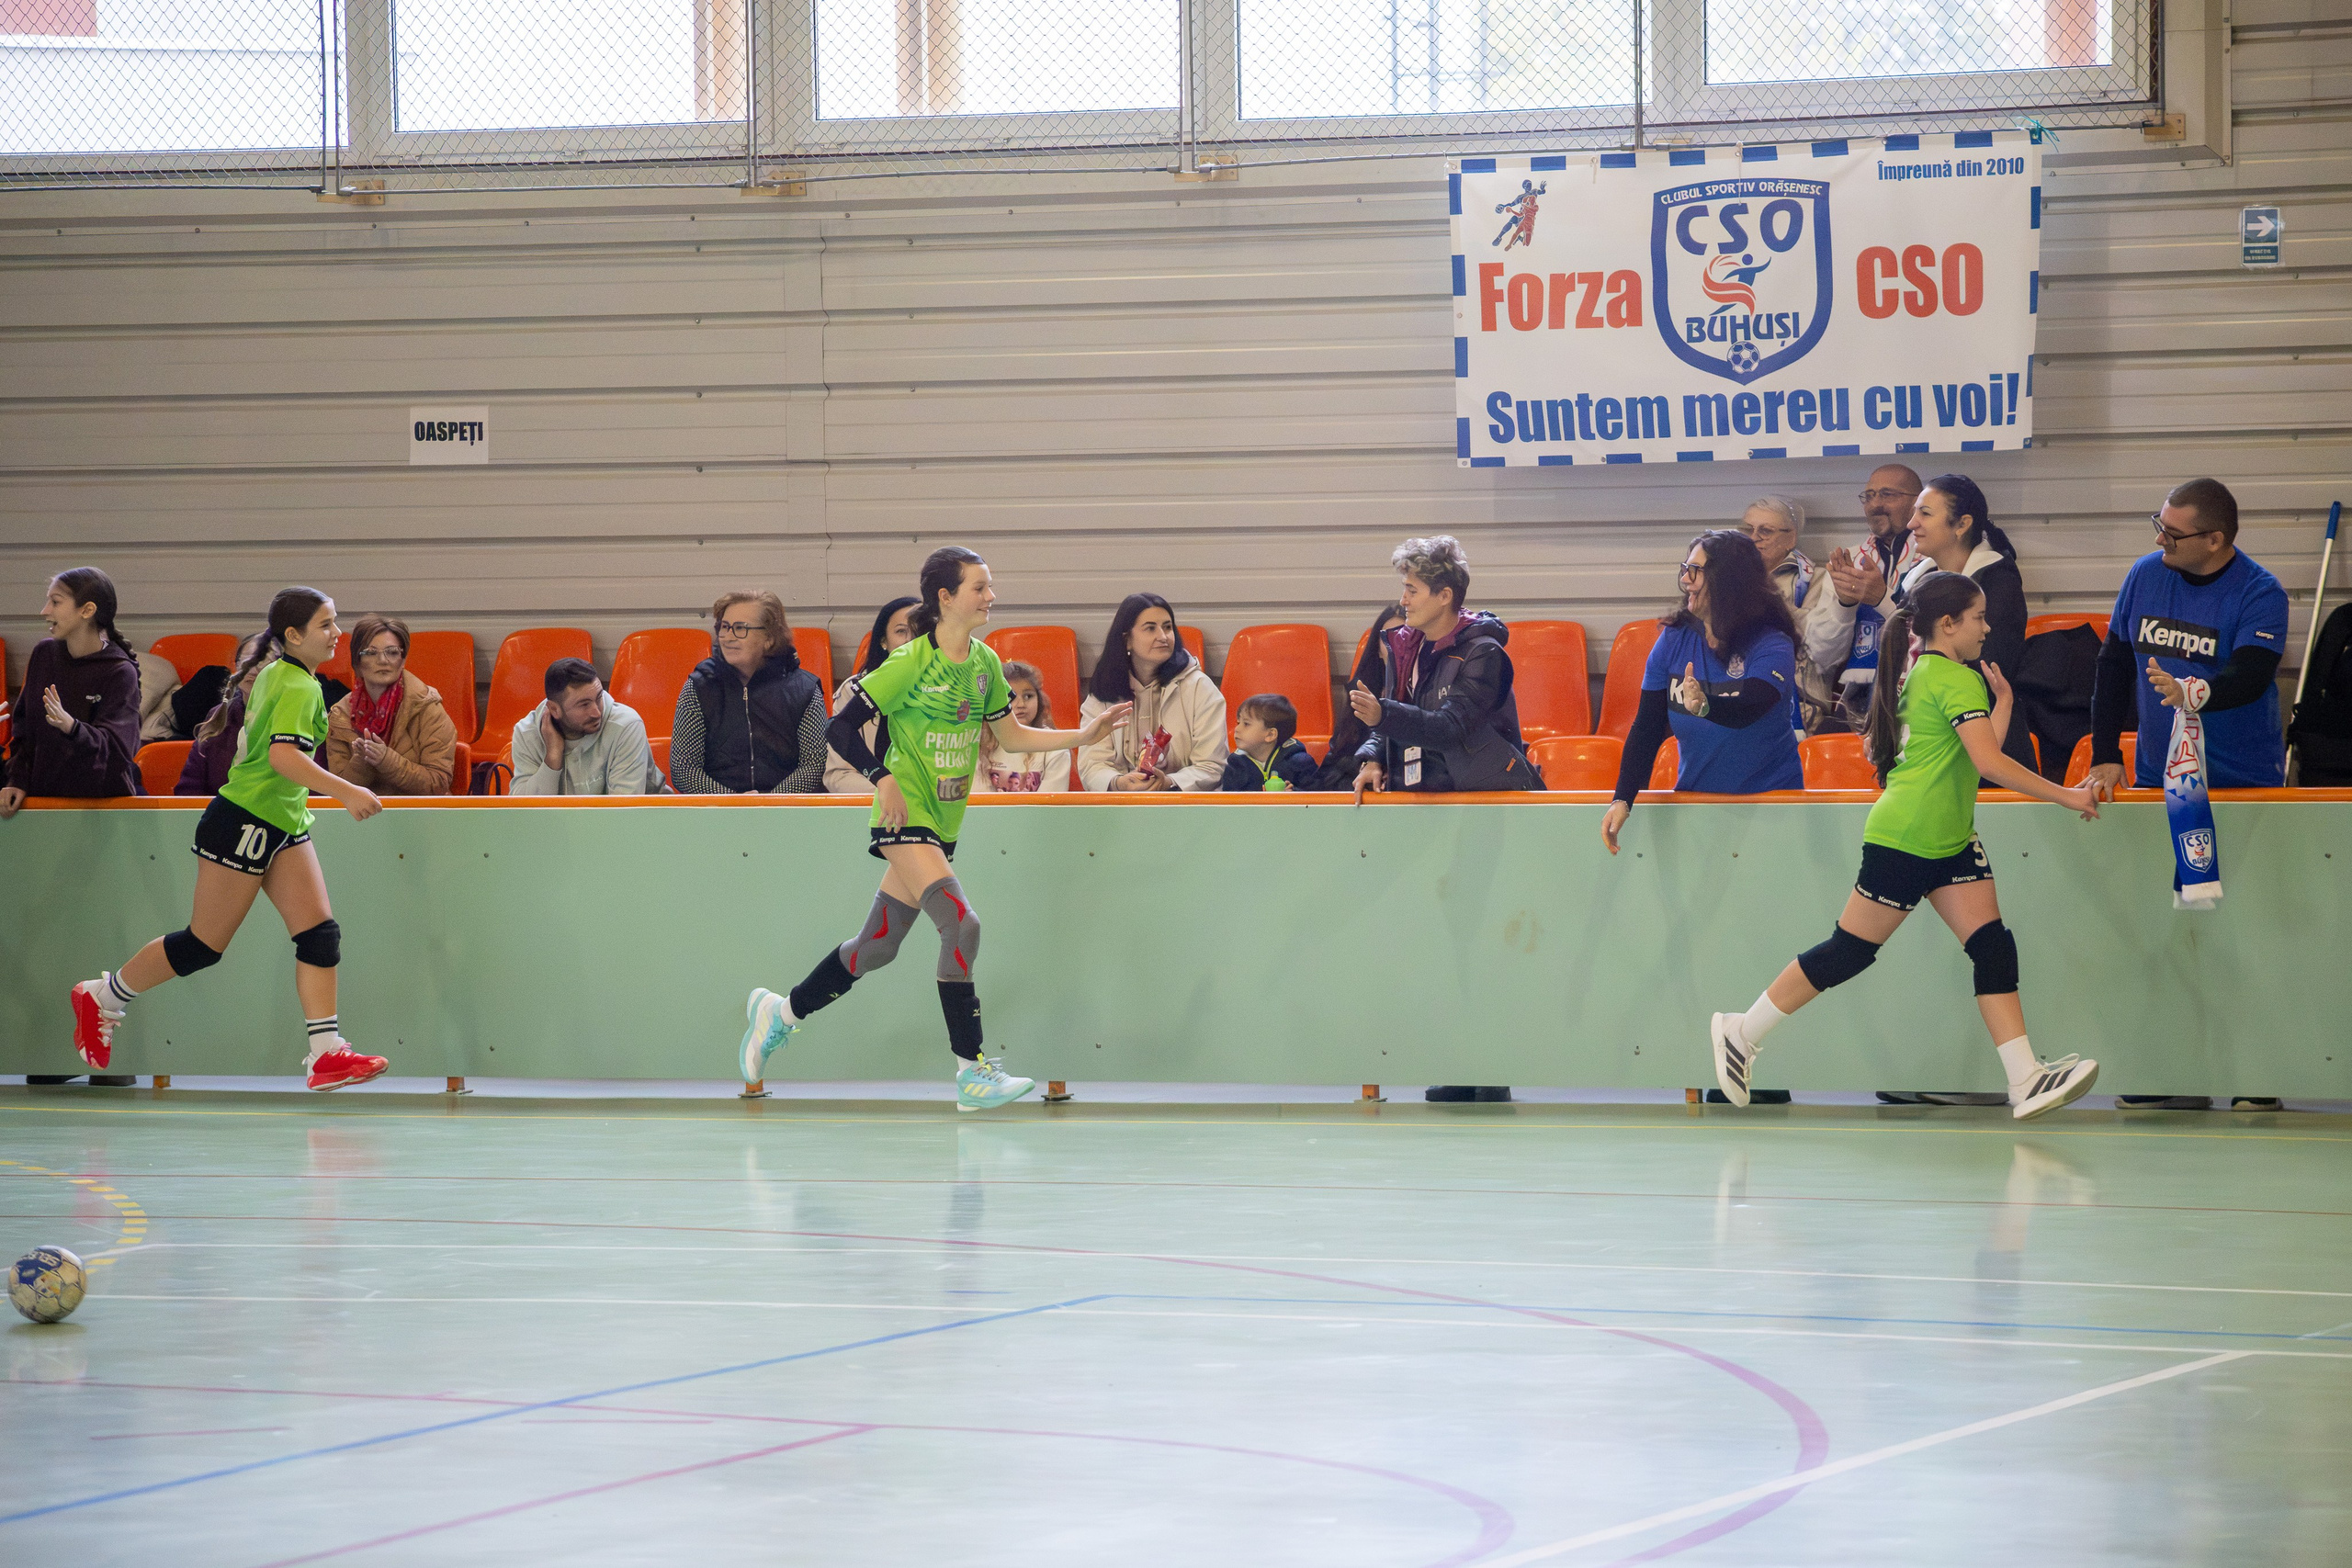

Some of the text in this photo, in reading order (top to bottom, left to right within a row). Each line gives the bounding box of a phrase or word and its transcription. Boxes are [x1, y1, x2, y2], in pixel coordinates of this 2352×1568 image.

[1877, 157, 2025, 181] Împreună din 2010
[1660, 187, 1703, 205] CLUBUL
[1705, 182, 1756, 197] SPORTIV
[1676, 198, 1804, 255] CSO
[1856, 243, 1984, 319] CSO
[1478, 262, 1644, 332] Forza
[1486, 372, 2019, 444] Suntem mereu cu voi!
[414, 421, 483, 446] OASPEȚI
[2138, 618, 2216, 658] Kempa
[1962, 711, 1985, 719] Kempa
[234, 823, 268, 861] 10
[900, 835, 922, 843] Kempa
[2186, 833, 2210, 847] CSO
[199, 847, 218, 860] Kempa
[221, 857, 243, 870] Kempa
[1951, 874, 1977, 883] Kempa
[1878, 895, 1901, 908] Kempa
